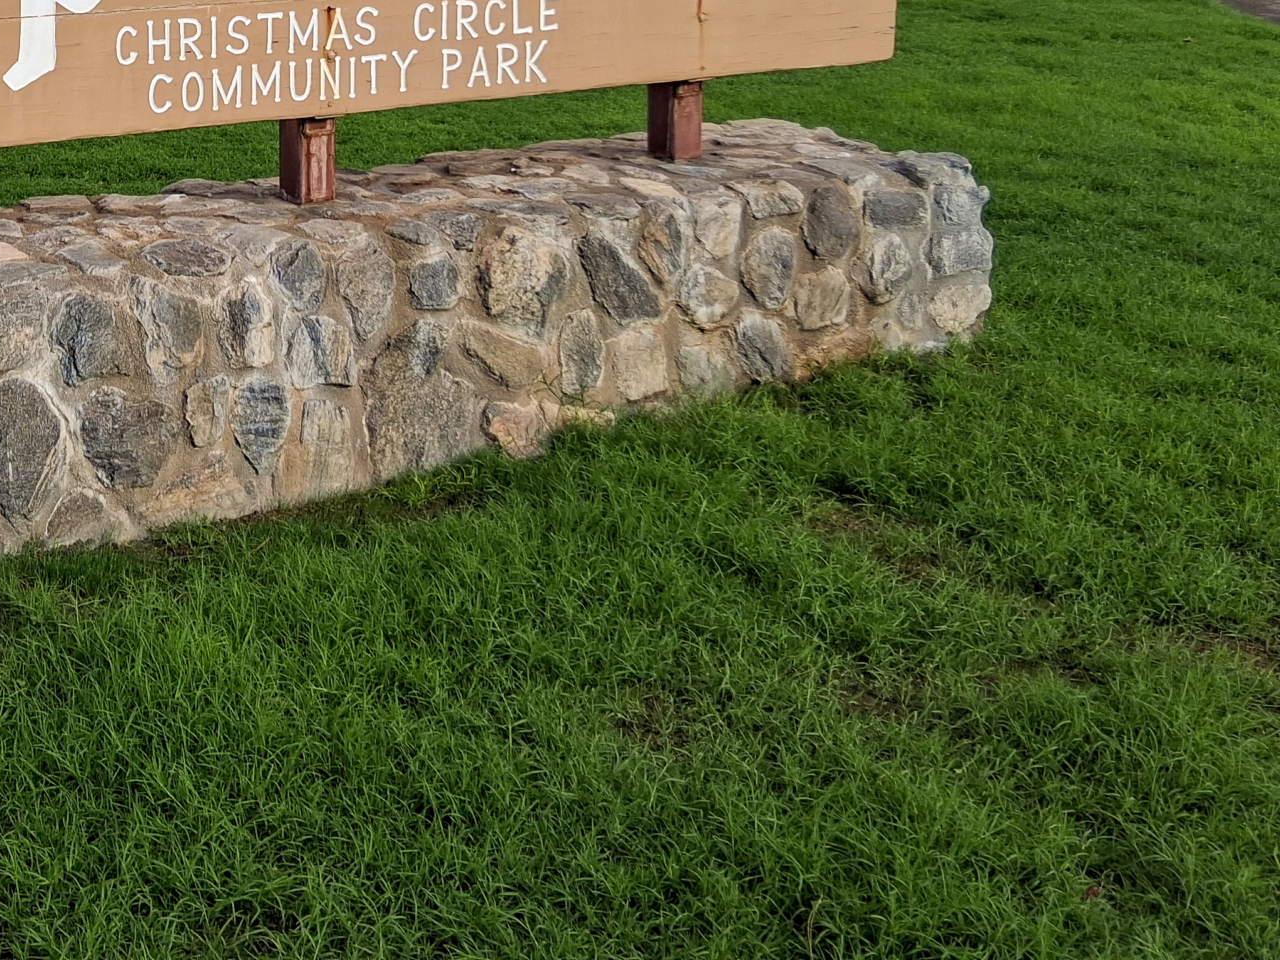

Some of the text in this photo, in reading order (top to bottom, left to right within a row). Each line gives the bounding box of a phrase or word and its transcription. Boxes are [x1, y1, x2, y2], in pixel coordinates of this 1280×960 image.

[115, 1, 381, 71] CHRISTMAS
[148, 38, 550, 114] COMMUNITY PARK
